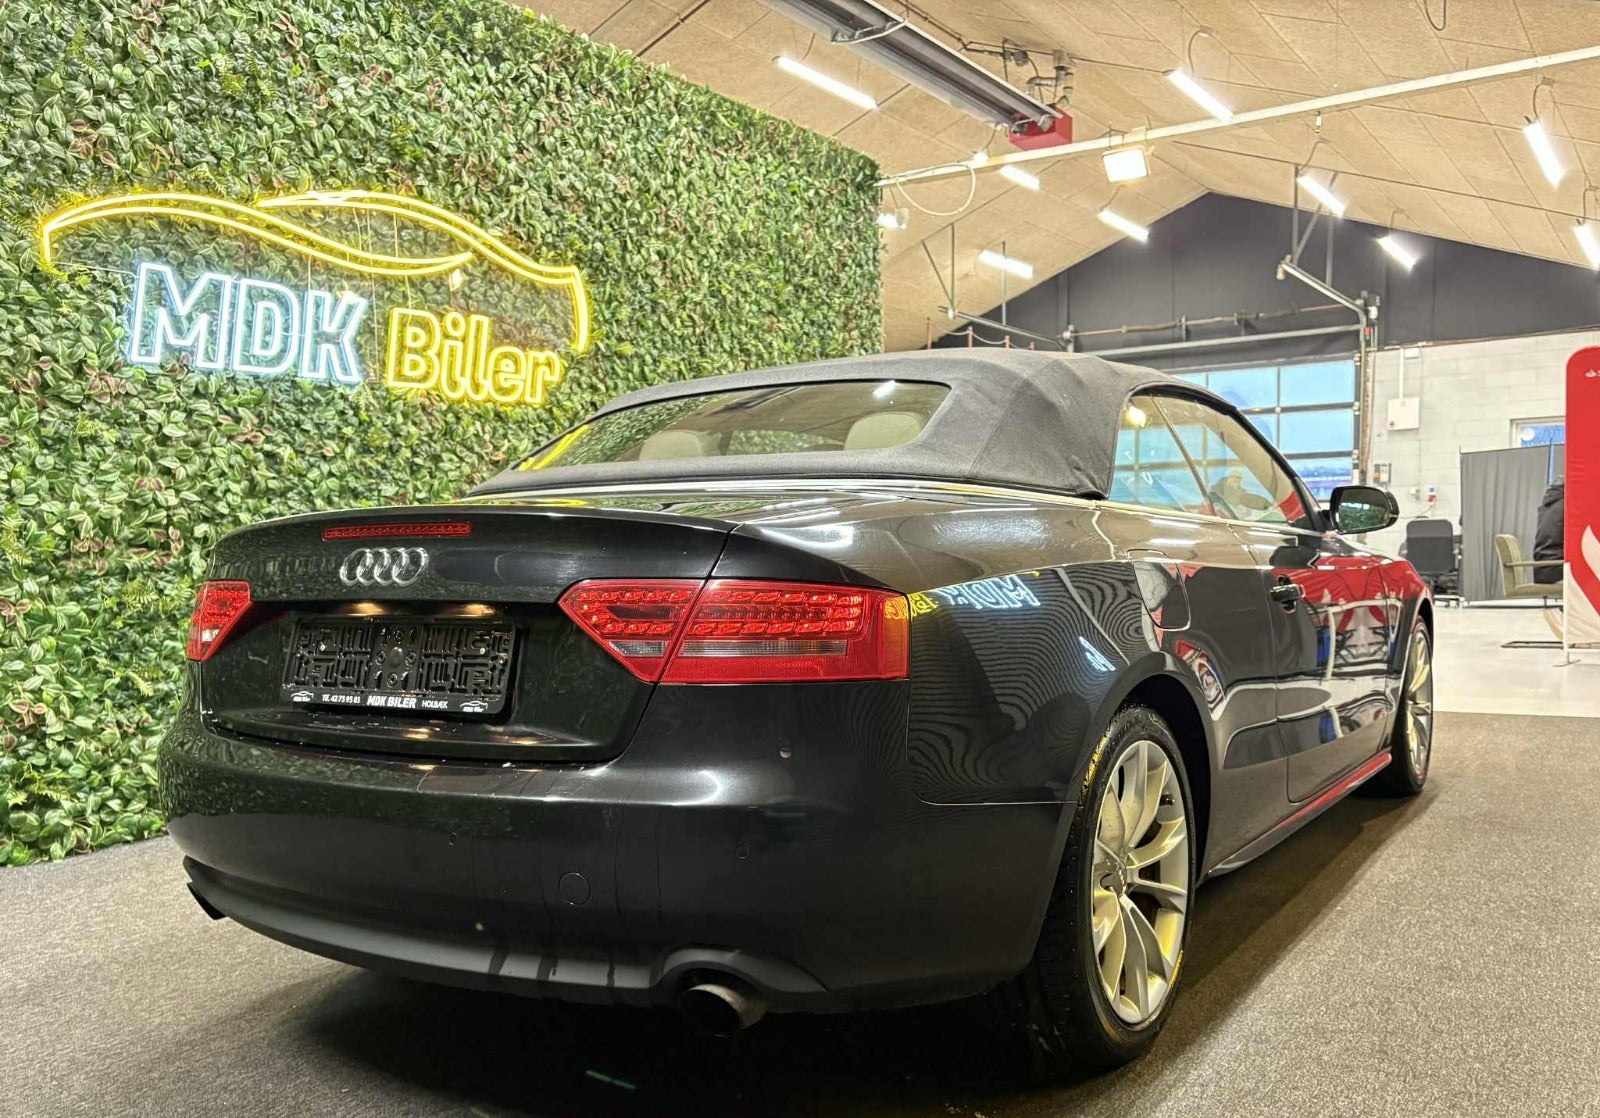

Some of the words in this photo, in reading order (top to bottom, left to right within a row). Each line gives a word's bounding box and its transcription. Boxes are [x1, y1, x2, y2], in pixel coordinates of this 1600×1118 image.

[130, 262, 367, 384] MDK
[387, 307, 560, 402] Biler
[366, 695, 387, 707] MDK
[387, 696, 417, 709] BILER
